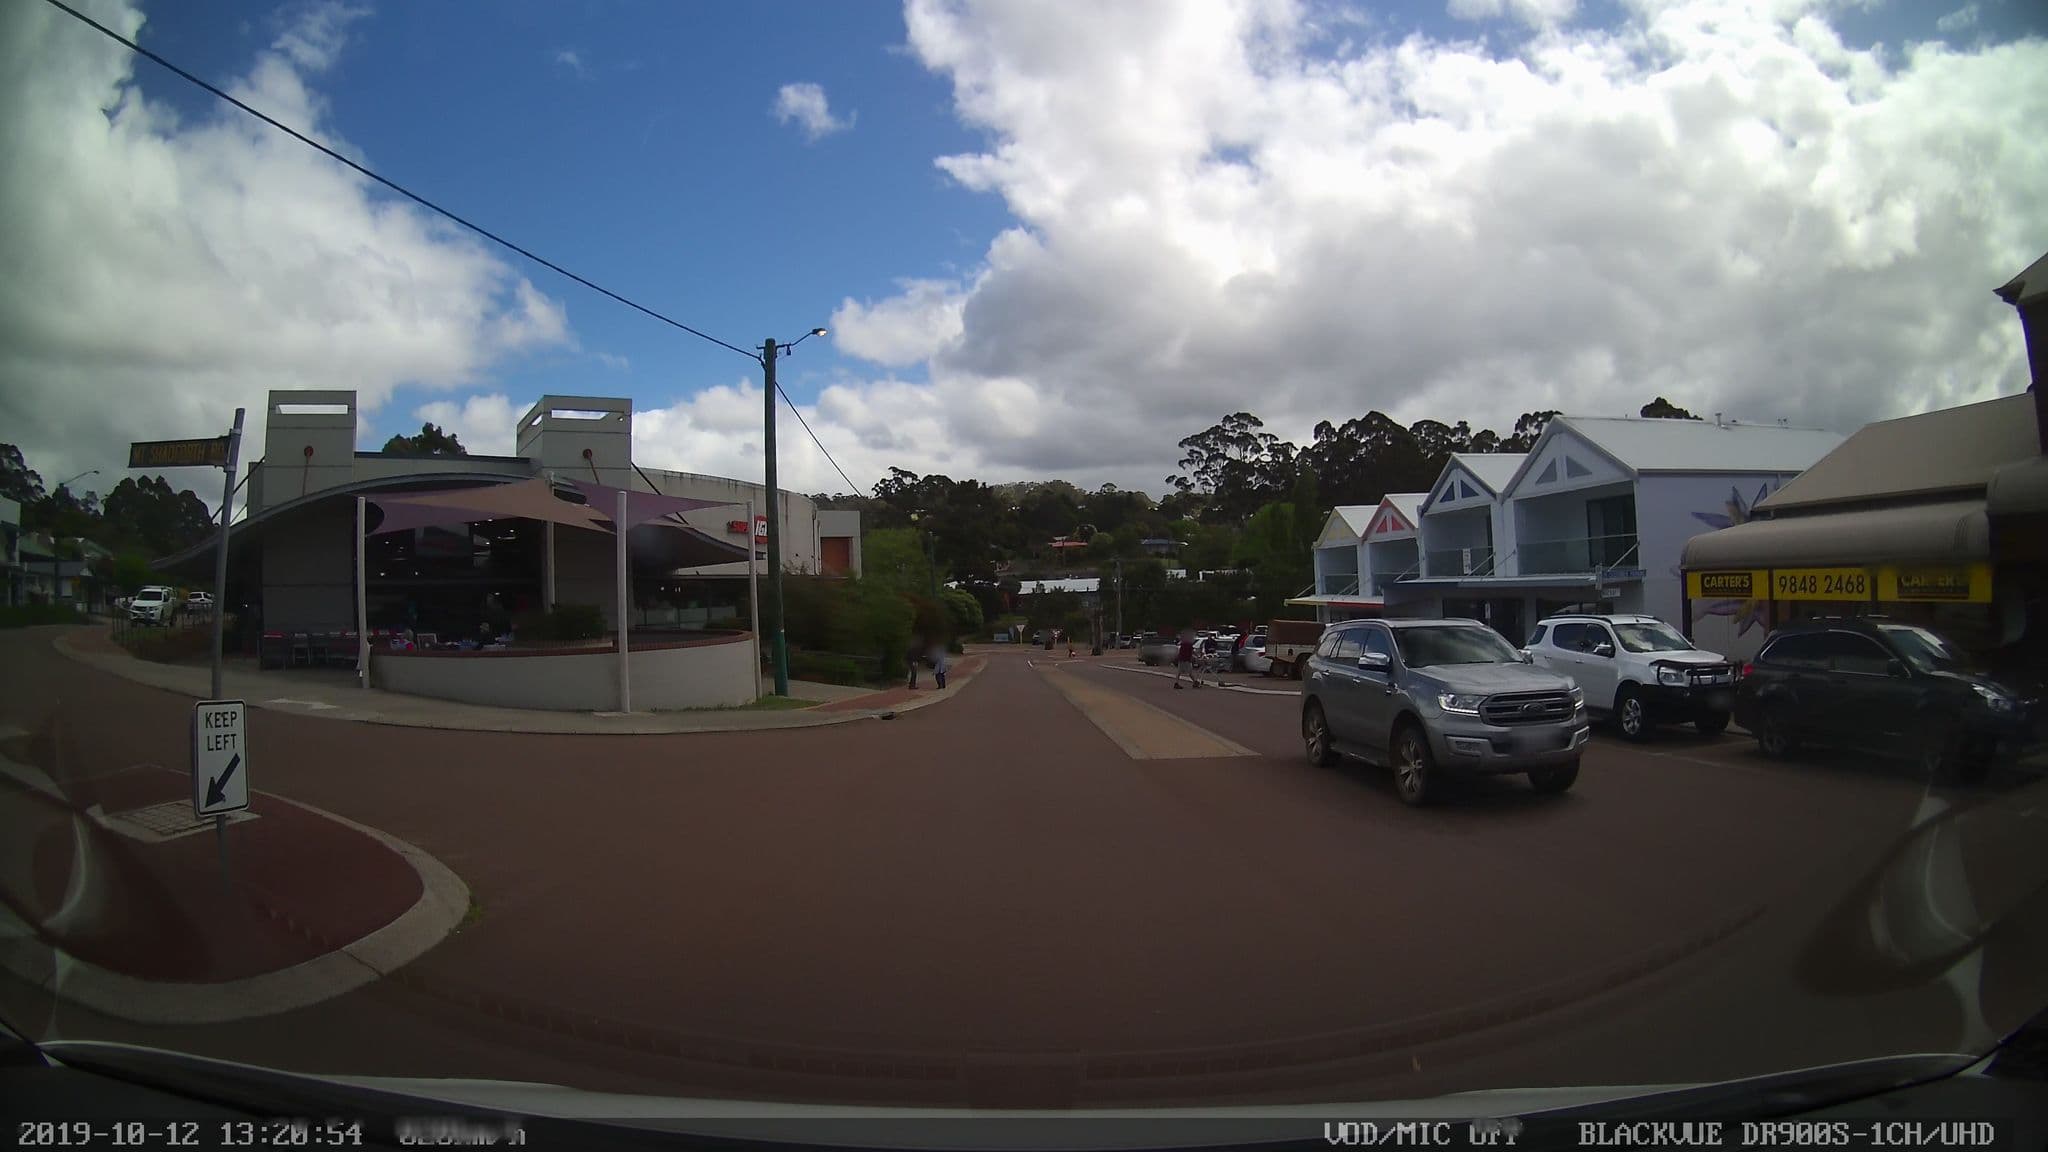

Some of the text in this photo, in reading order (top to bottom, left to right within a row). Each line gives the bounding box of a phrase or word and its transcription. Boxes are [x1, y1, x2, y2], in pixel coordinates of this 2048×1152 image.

[1703, 575, 1750, 588] CARTER'S
[1778, 574, 1865, 594] 9848 2468
[205, 711, 237, 729] KEEP
[207, 733, 237, 751] LEFT
